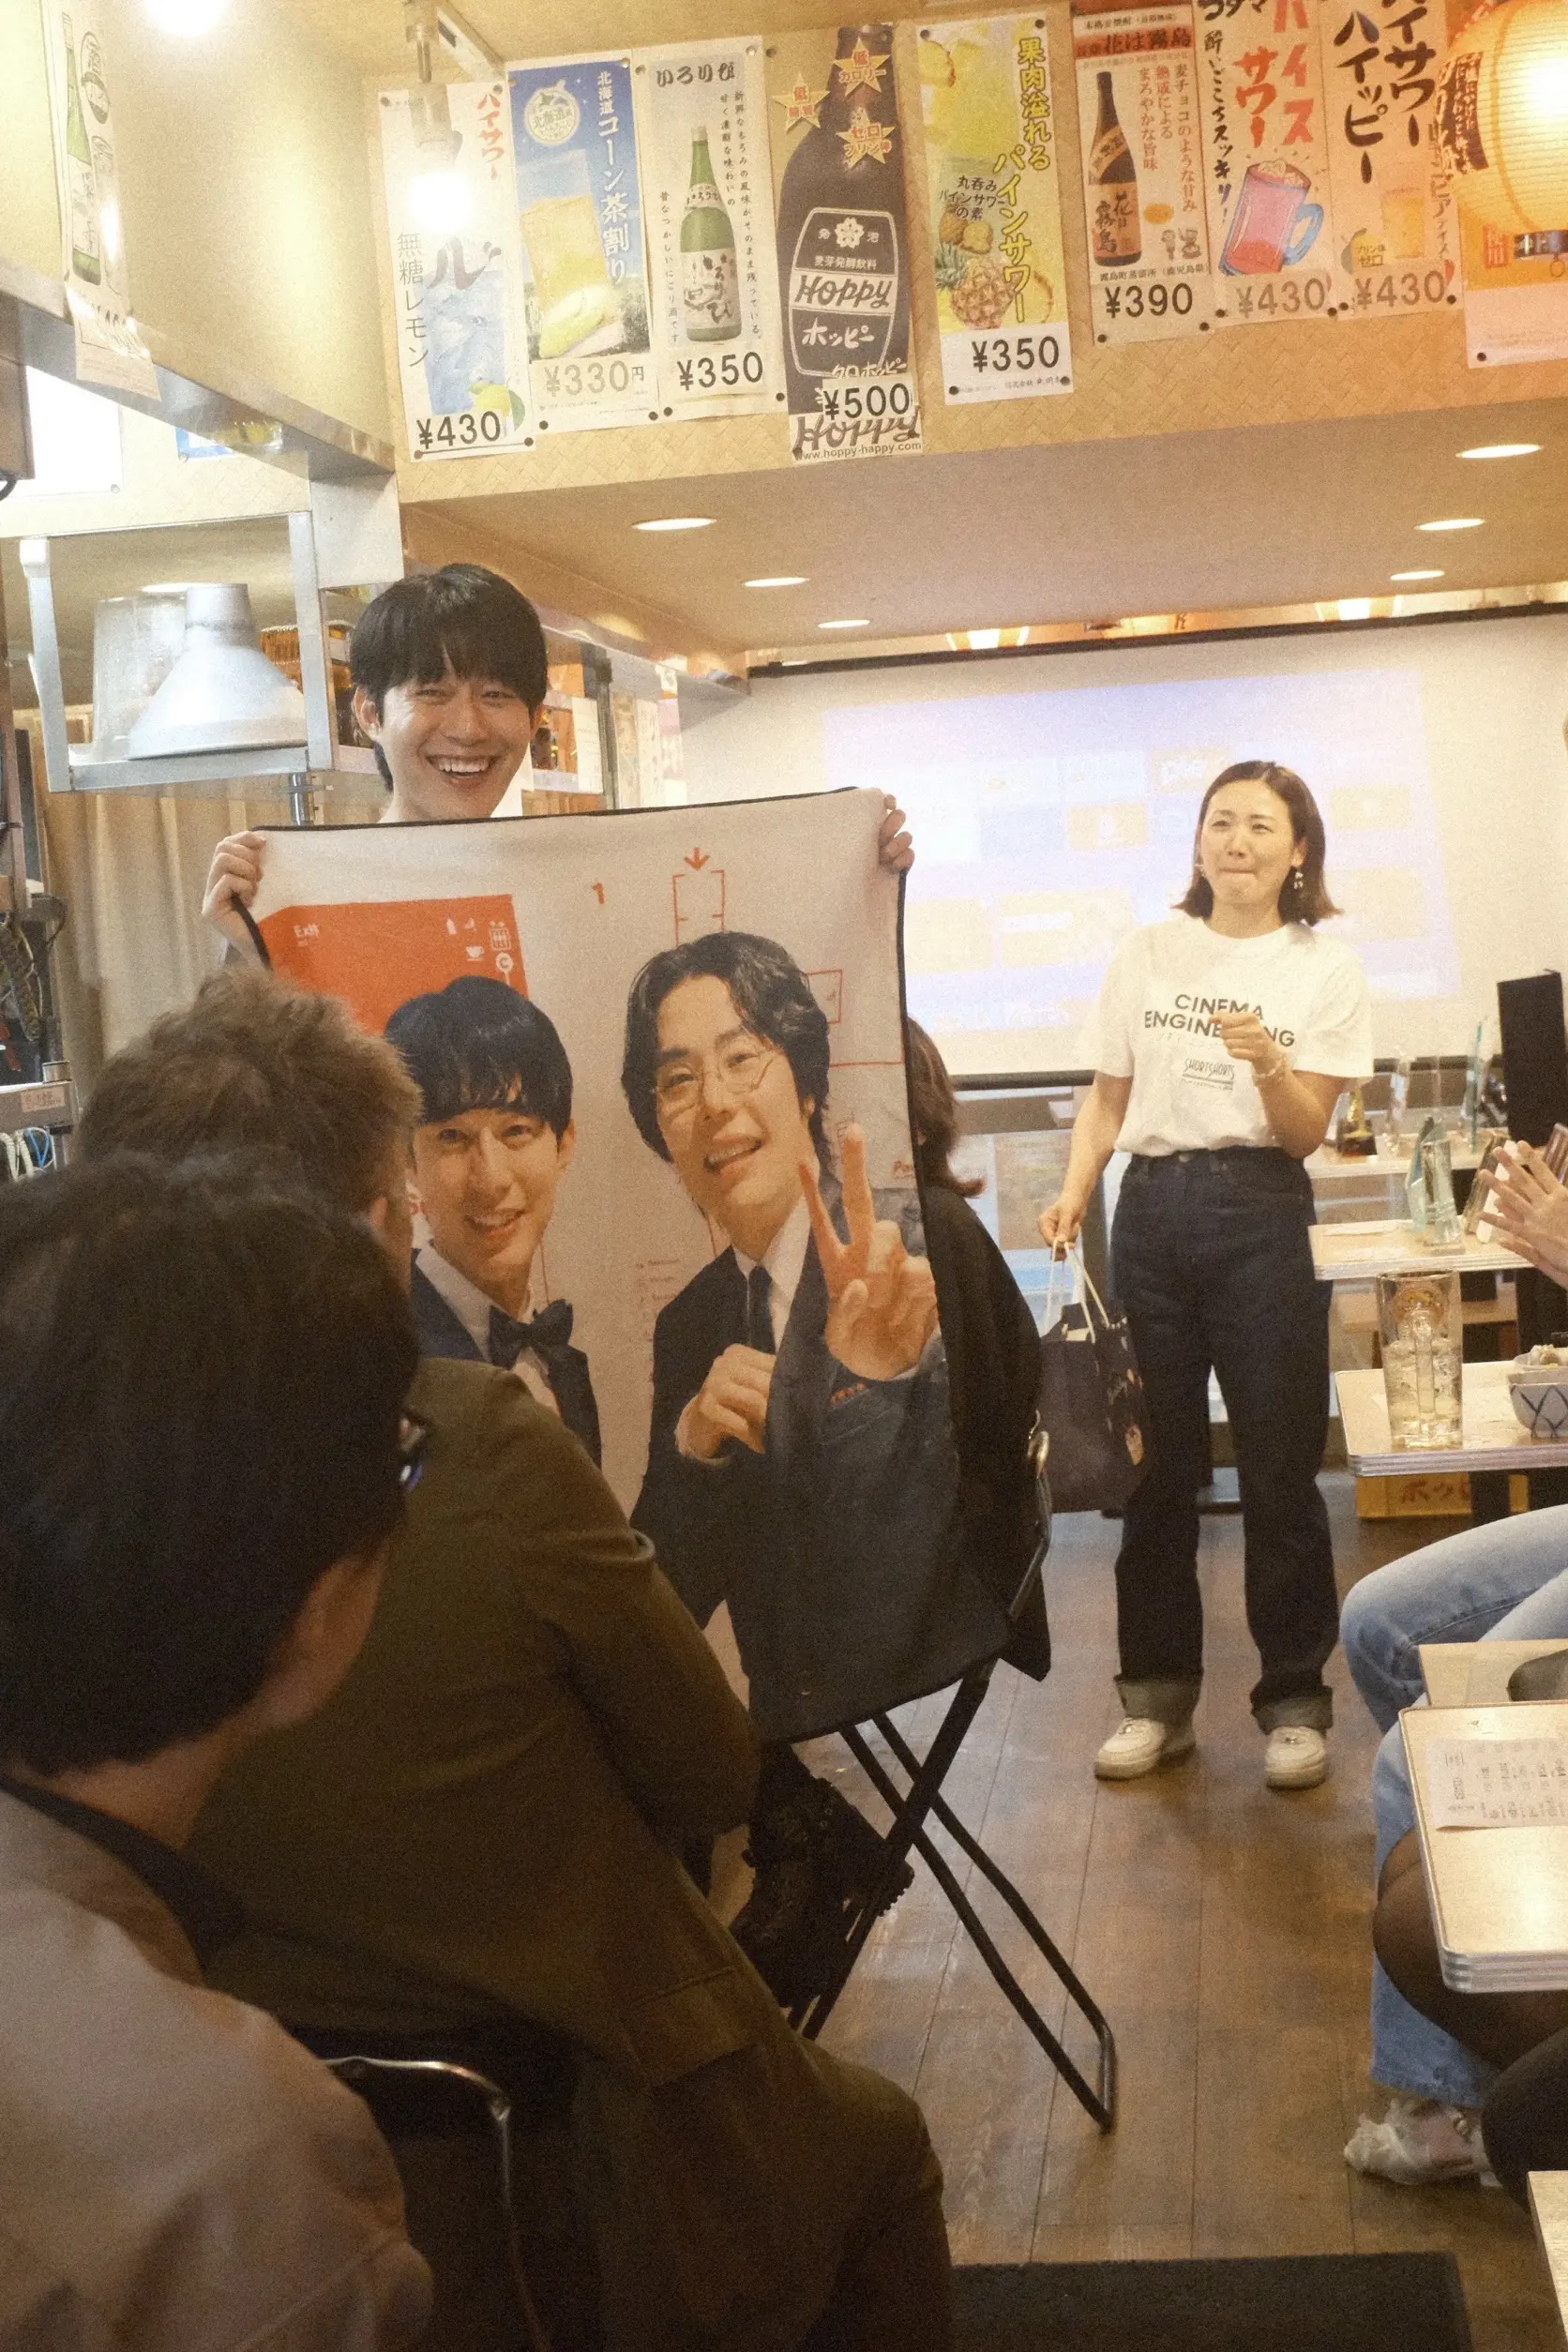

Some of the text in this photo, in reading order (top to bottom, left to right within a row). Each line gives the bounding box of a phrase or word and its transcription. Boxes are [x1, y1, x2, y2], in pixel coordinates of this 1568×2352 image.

[1381, 0, 1437, 148] イサワー
[1018, 37, 1051, 172] 果肉溢れる
[1233, 45, 1279, 148] サワー
[1334, 9, 1389, 185] ハイッピー
[476, 94, 505, 180] ハイサワー
[957, 175, 997, 190] 丸呑み
[957, 207, 983, 221] の素
[993, 144, 1033, 324] パインサワー
[398, 232, 429, 367] 無糖レモン
[794, 275, 893, 309] Hoppy
[1105, 282, 1193, 319] ¥390
[1236, 278, 1325, 318] ¥430
[1354, 270, 1445, 310] ¥430
[802, 318, 875, 349] ホッピー
[677, 352, 763, 391] ¥350
[971, 336, 1060, 372] ¥350
[823, 383, 910, 420] ¥500
[416, 411, 501, 450] ¥430
[1175, 994, 1264, 1020] CINEMA
[1145, 1011, 1295, 1047] ENGINENG
